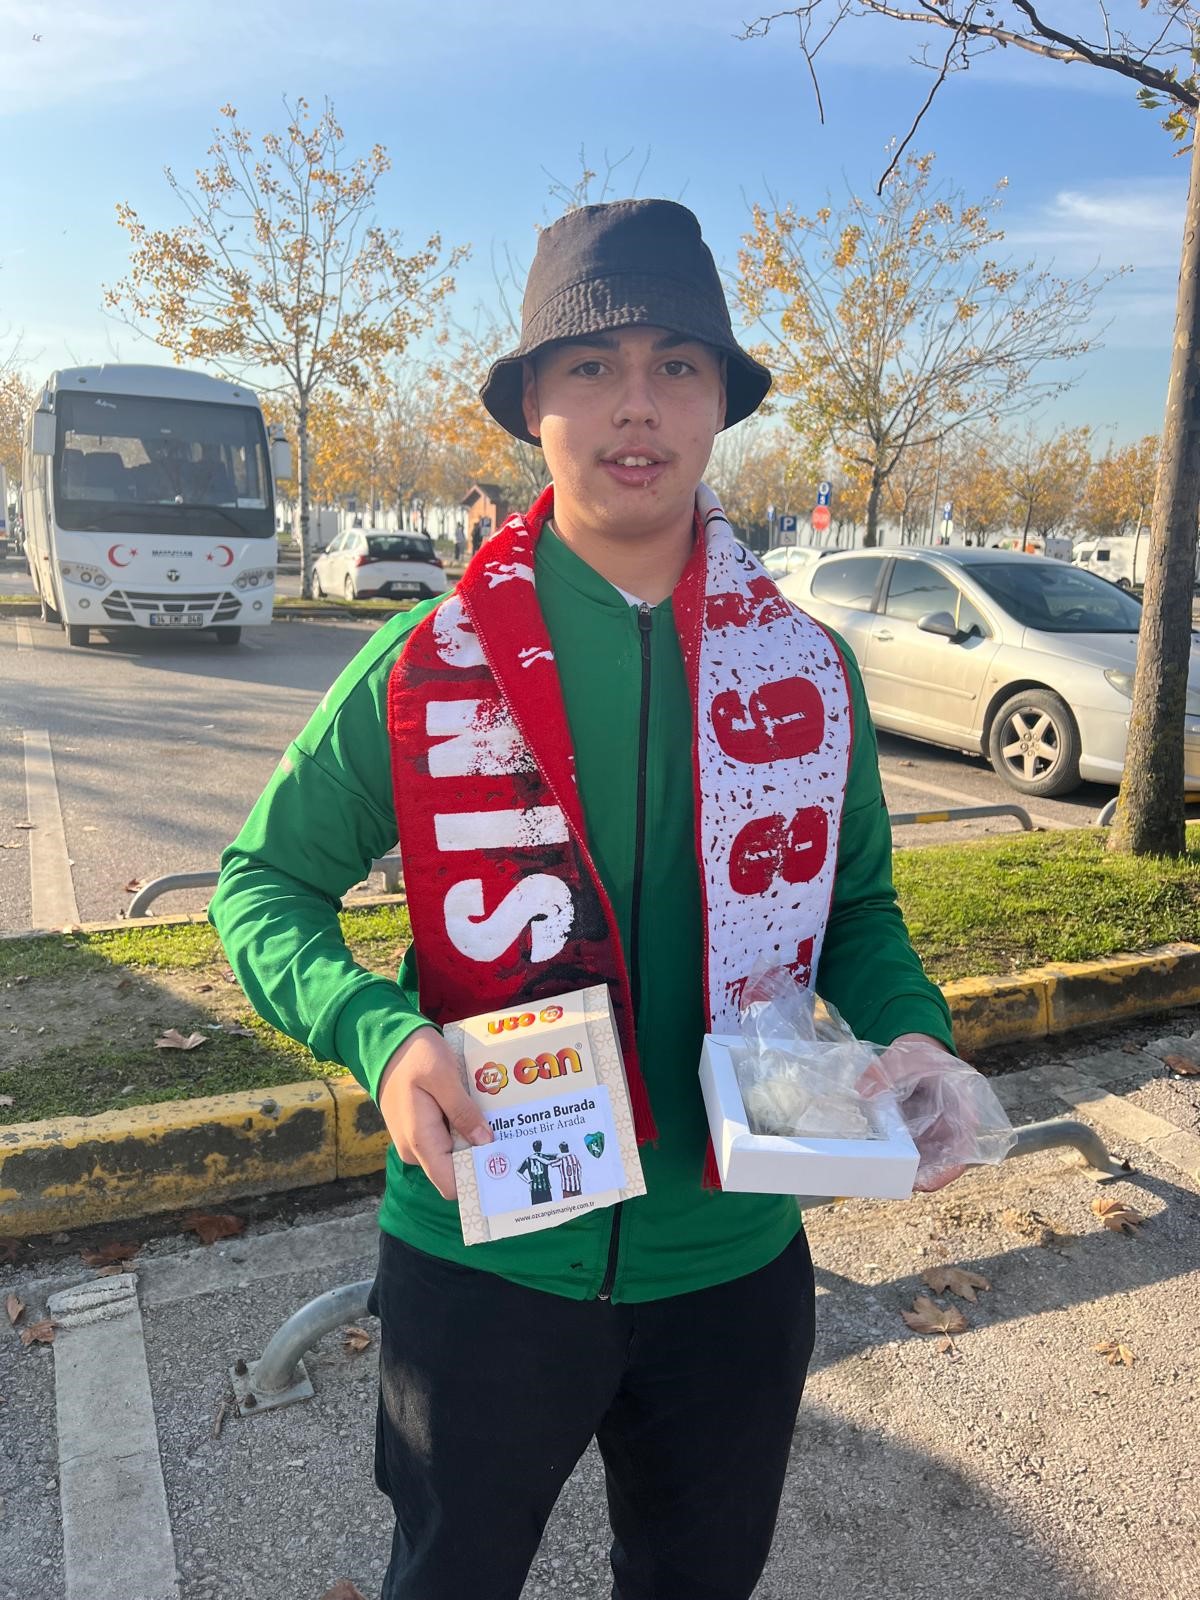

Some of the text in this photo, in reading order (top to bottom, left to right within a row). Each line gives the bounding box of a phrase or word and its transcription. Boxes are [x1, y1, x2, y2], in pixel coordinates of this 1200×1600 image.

[784, 517, 794, 531] P
[517, 1110, 552, 1127] Sonra
[553, 1099, 596, 1118] Burada
[515, 1126, 538, 1139] Dost
[540, 1122, 555, 1134] Bir
[557, 1114, 586, 1130] Arada
